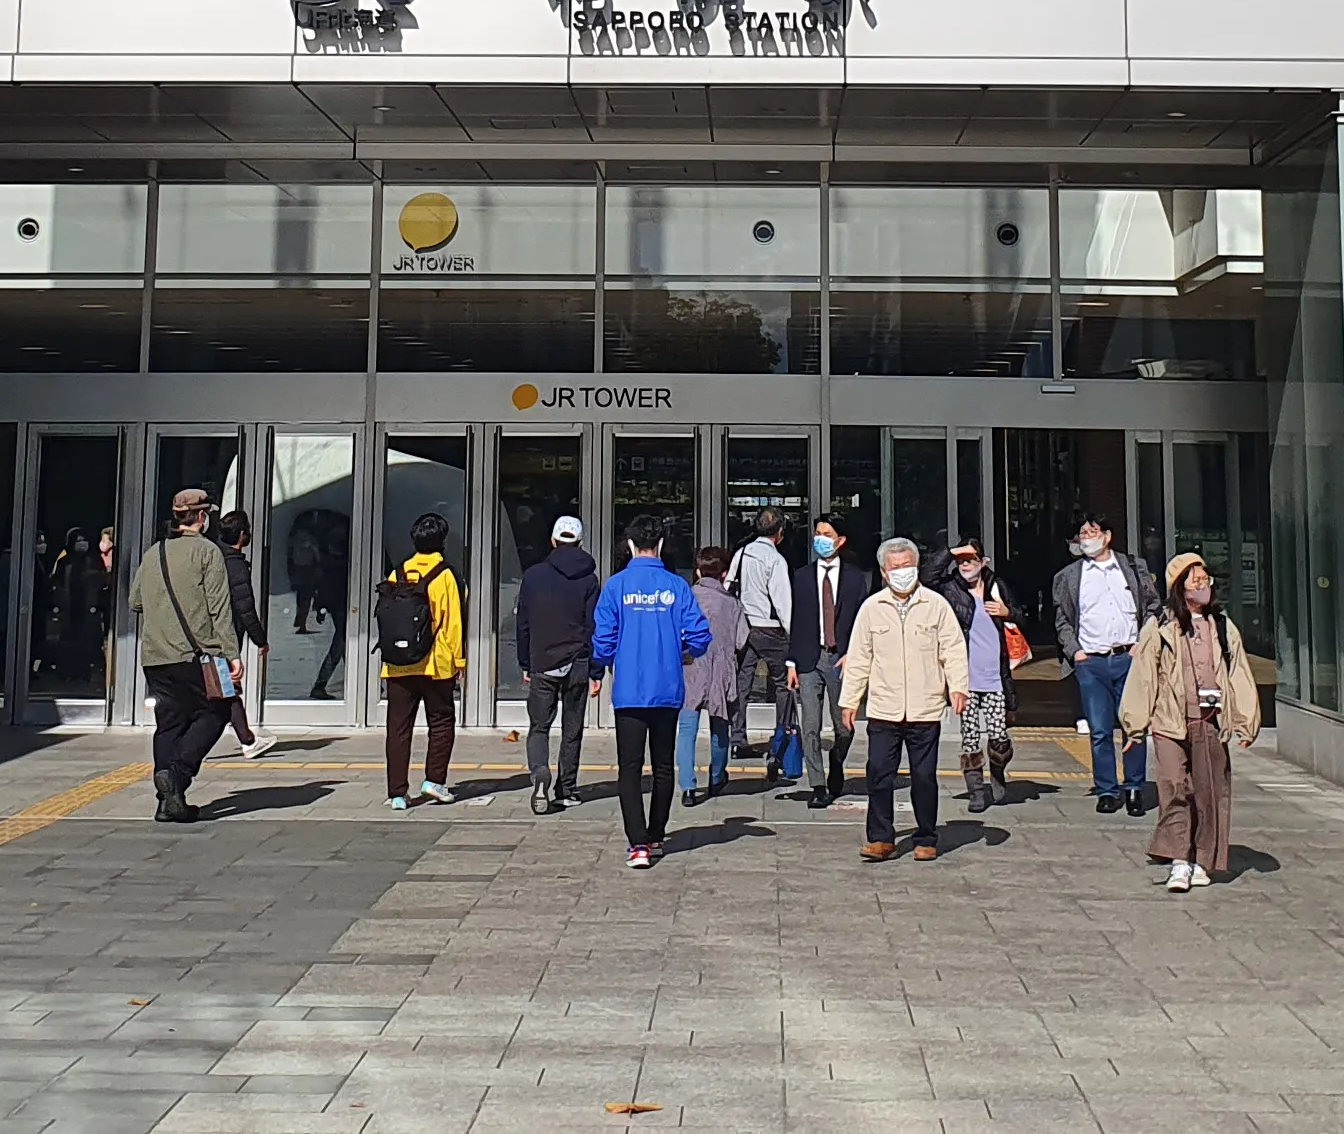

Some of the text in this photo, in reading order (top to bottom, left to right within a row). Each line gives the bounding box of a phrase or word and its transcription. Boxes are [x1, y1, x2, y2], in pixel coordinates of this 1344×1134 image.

[573, 11, 840, 32] SAPPORO STATION
[393, 256, 475, 272] JR TOWER
[541, 387, 672, 408] JR TOWER
[623, 589, 660, 605] unicef
